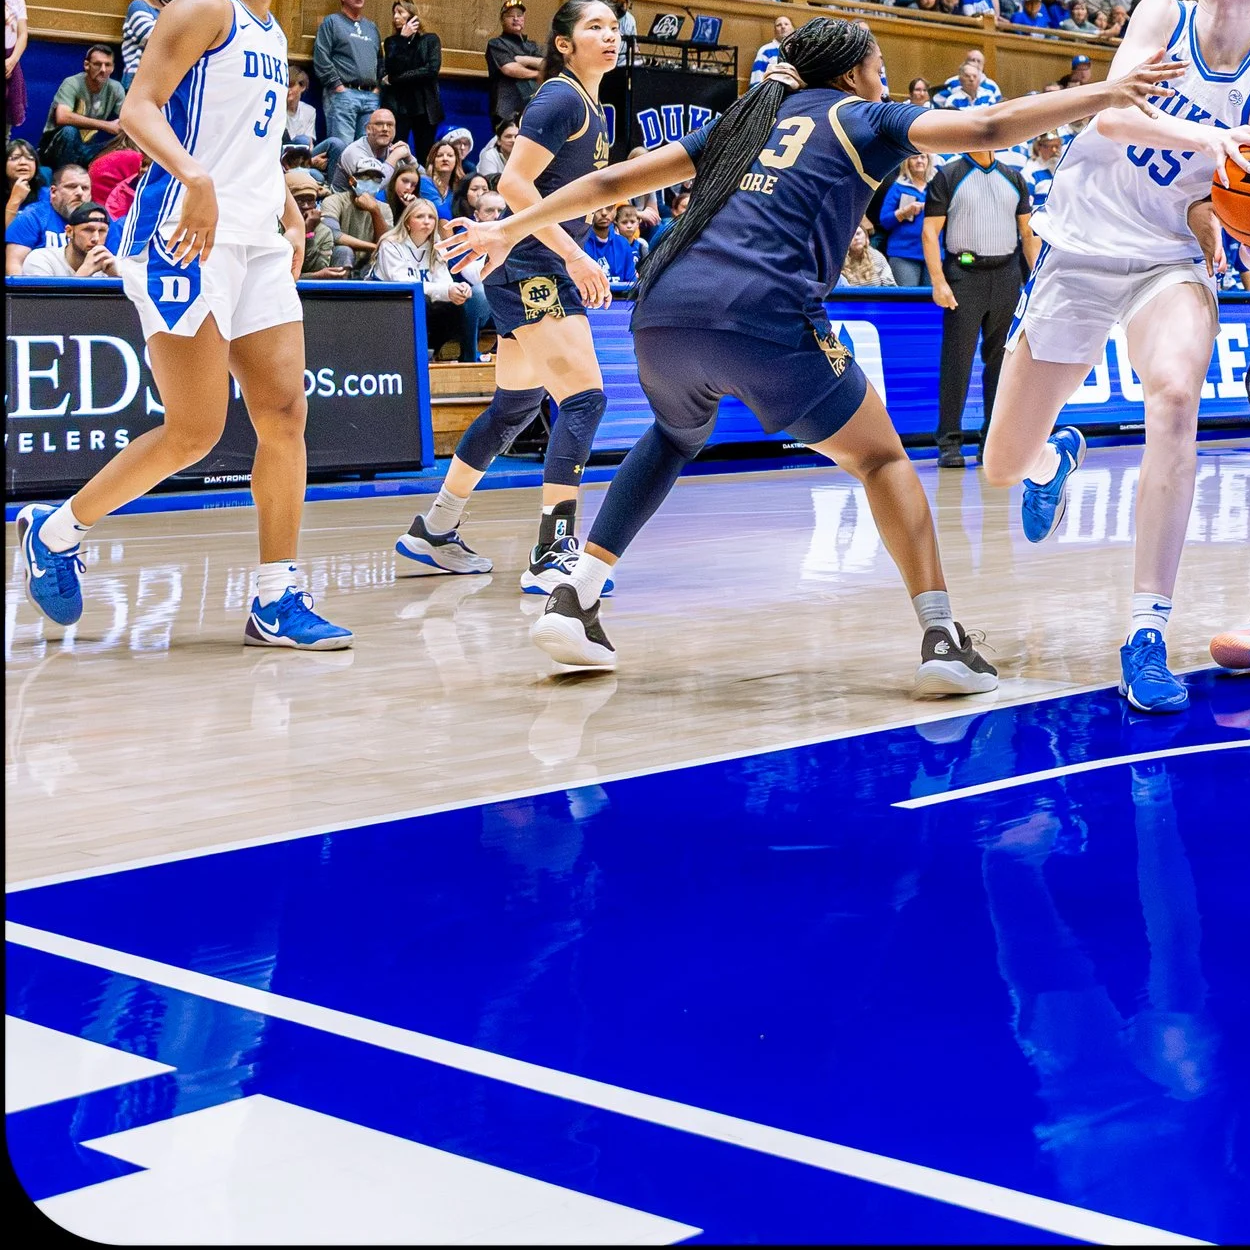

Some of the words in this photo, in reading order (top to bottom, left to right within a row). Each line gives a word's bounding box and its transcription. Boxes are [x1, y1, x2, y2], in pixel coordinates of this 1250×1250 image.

[254, 89, 277, 138] 3
[637, 104, 722, 151] DUK
[758, 116, 816, 170] 3
[739, 173, 779, 195] ORE
[204, 475, 253, 485] DAKTRONIC
